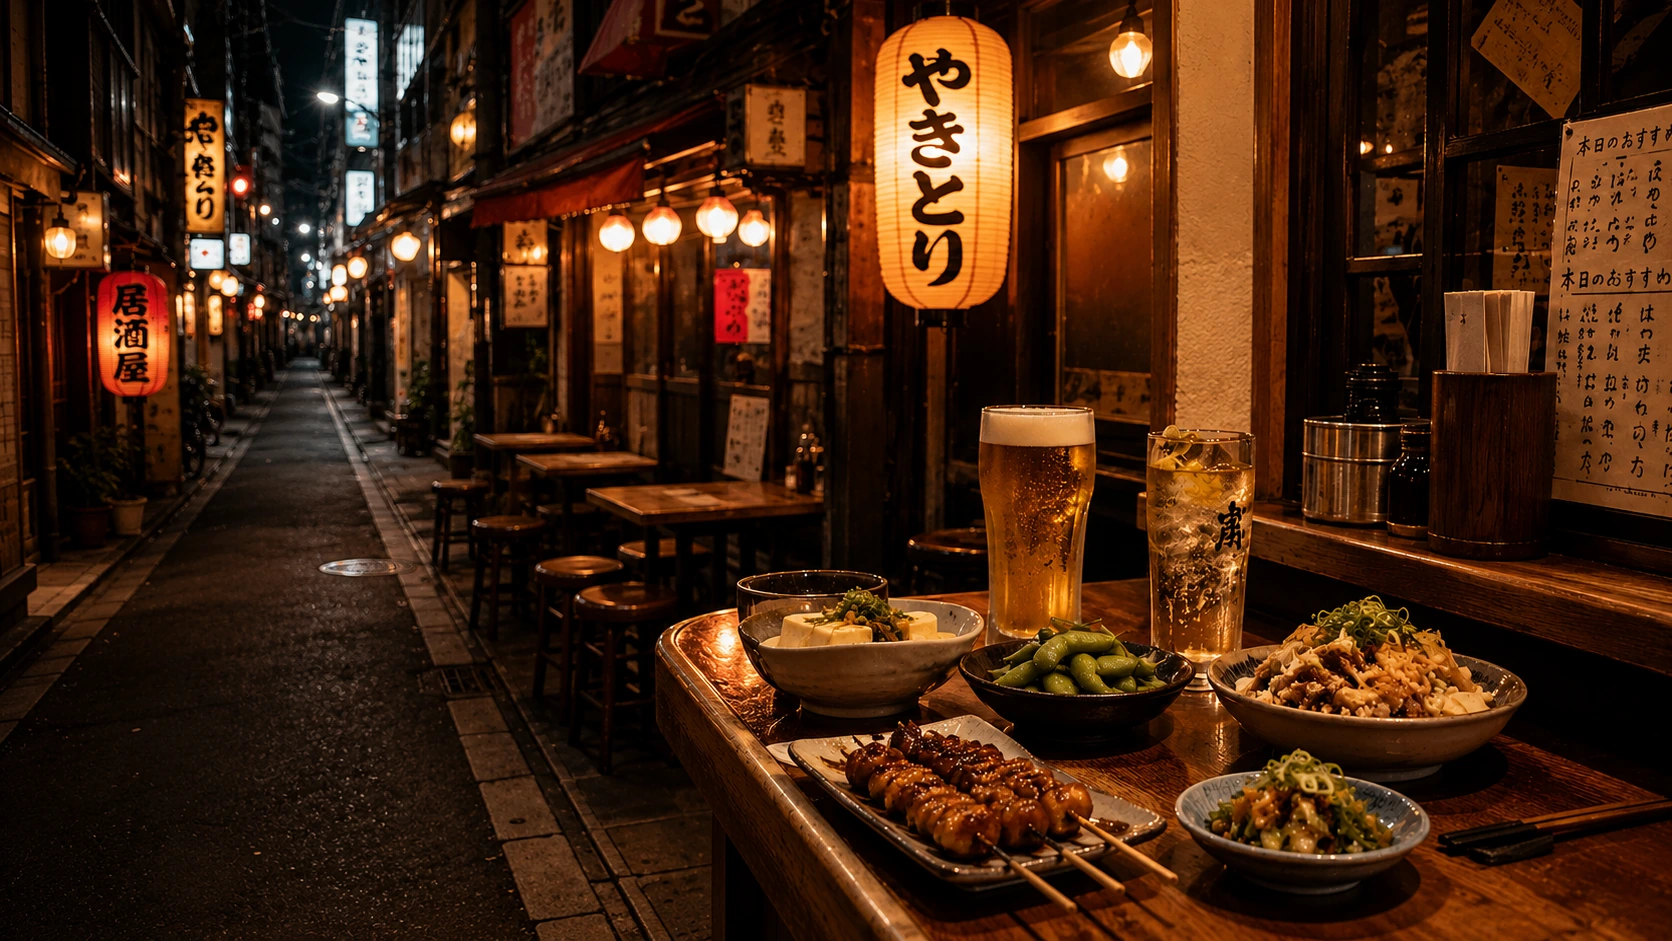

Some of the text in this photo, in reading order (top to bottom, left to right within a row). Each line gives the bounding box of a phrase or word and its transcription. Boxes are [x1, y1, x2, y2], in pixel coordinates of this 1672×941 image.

[902, 48, 971, 286] やきとり
[1560, 266, 1671, 292] 本日のおすすめ
[112, 283, 150, 383] 居酒屋
